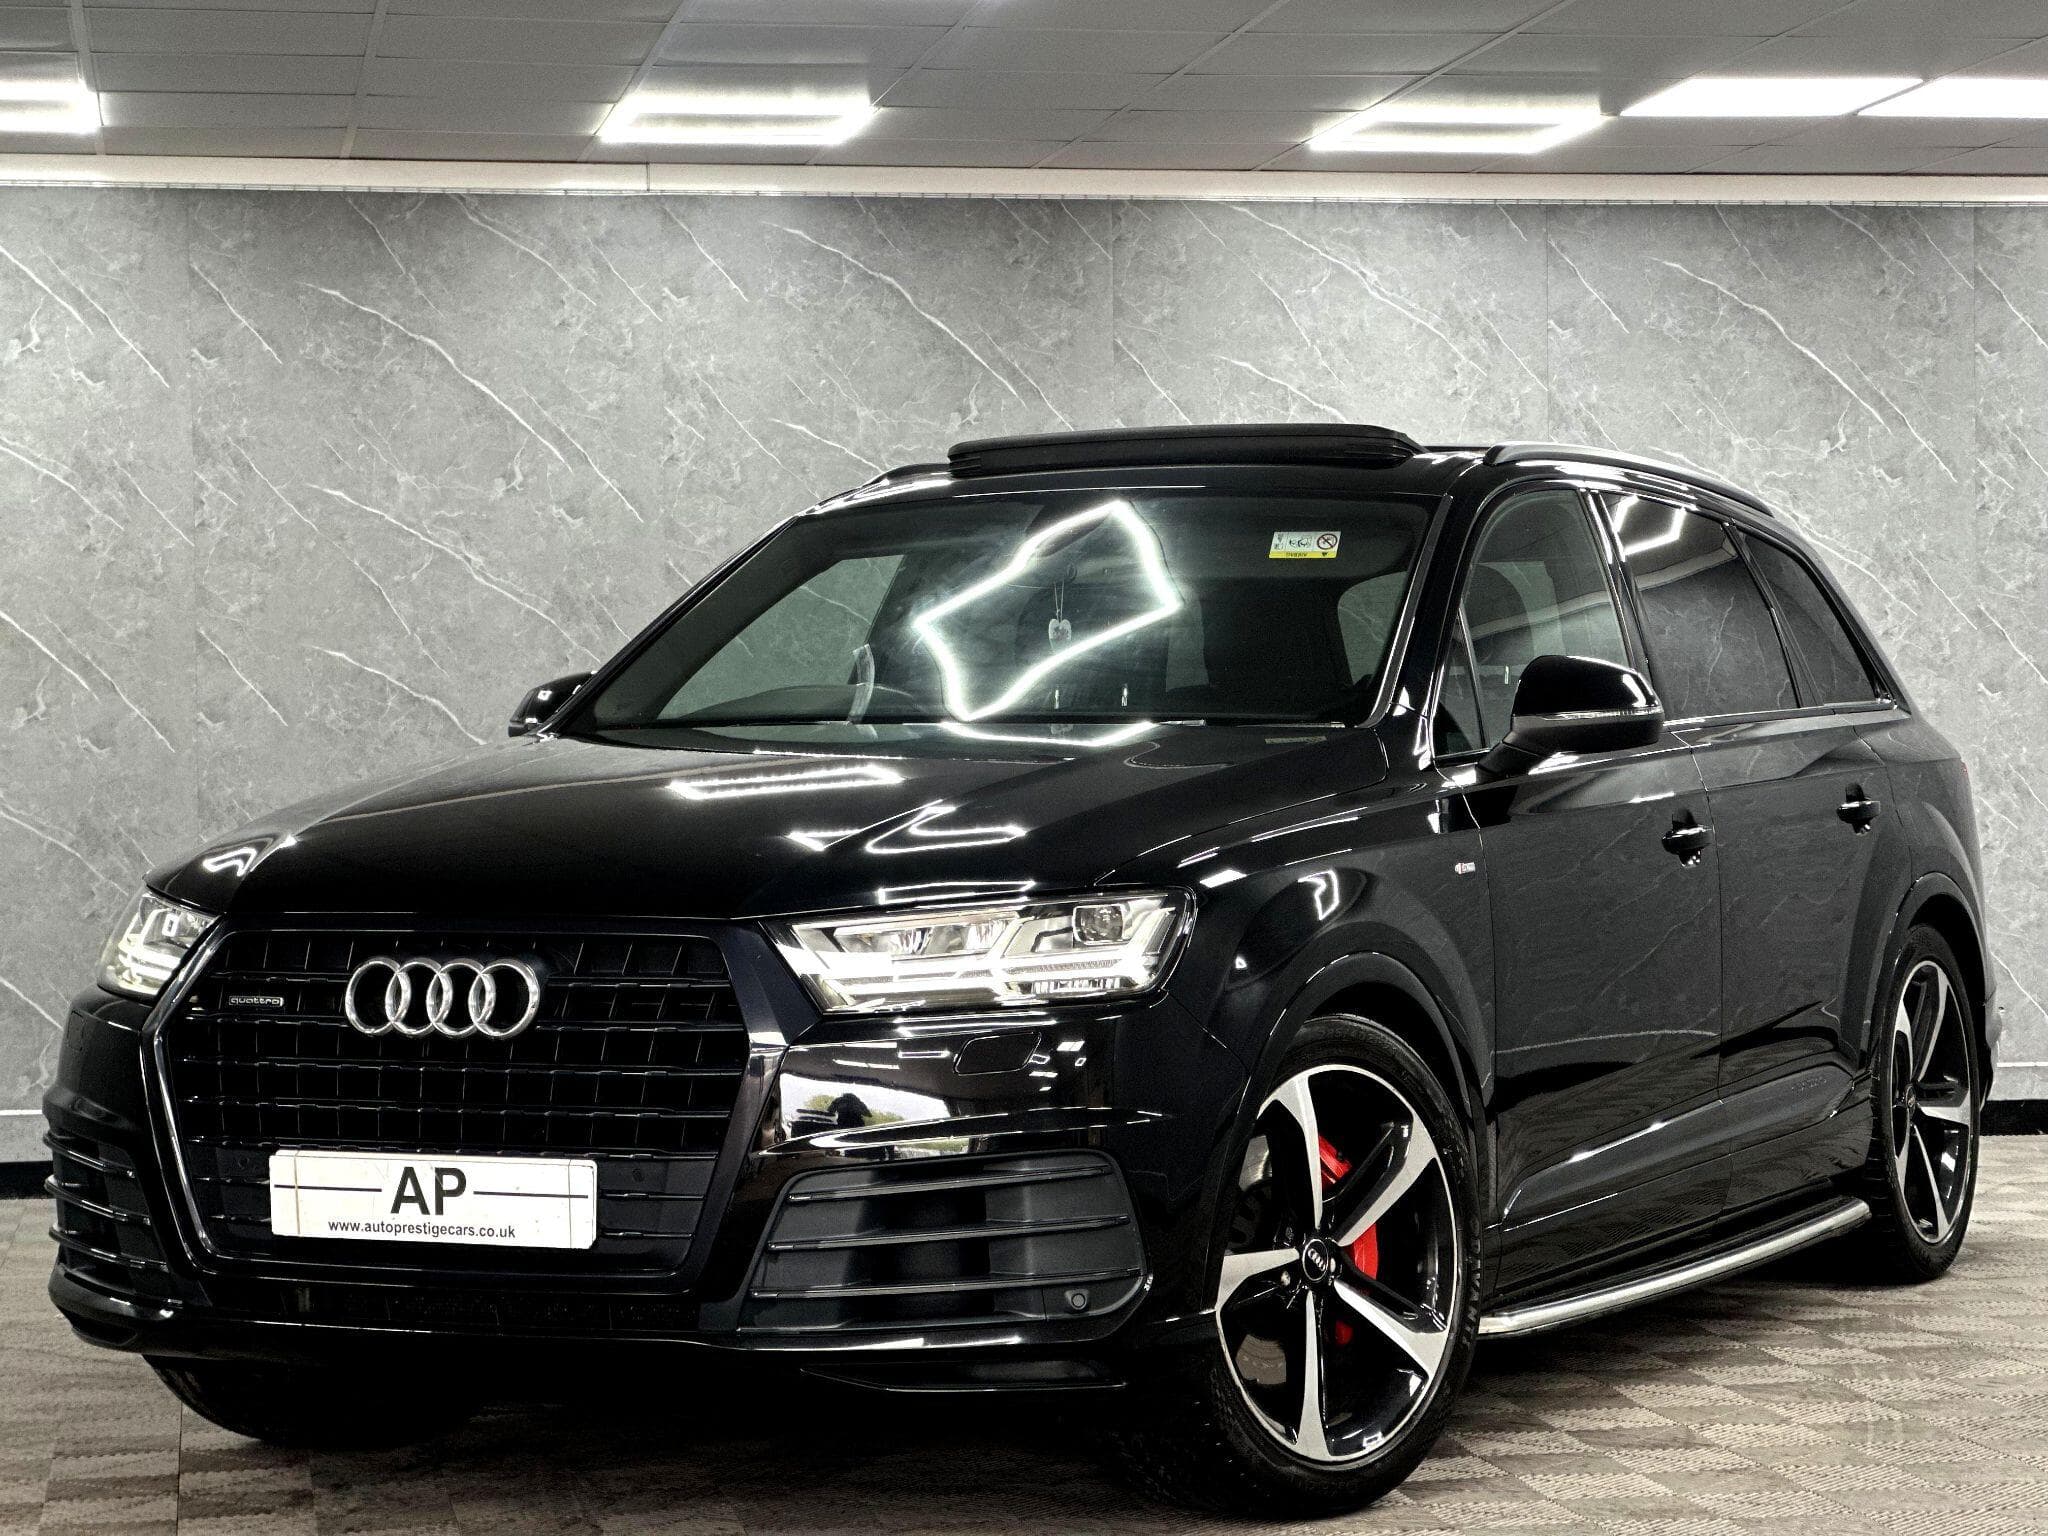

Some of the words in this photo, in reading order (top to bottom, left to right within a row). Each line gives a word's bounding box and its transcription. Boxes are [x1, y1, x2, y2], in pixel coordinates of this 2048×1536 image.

[230, 997, 280, 1005] quattro
[390, 1166, 467, 1216] AP
[328, 1220, 516, 1240] www.autoprestigecars.co.uk
